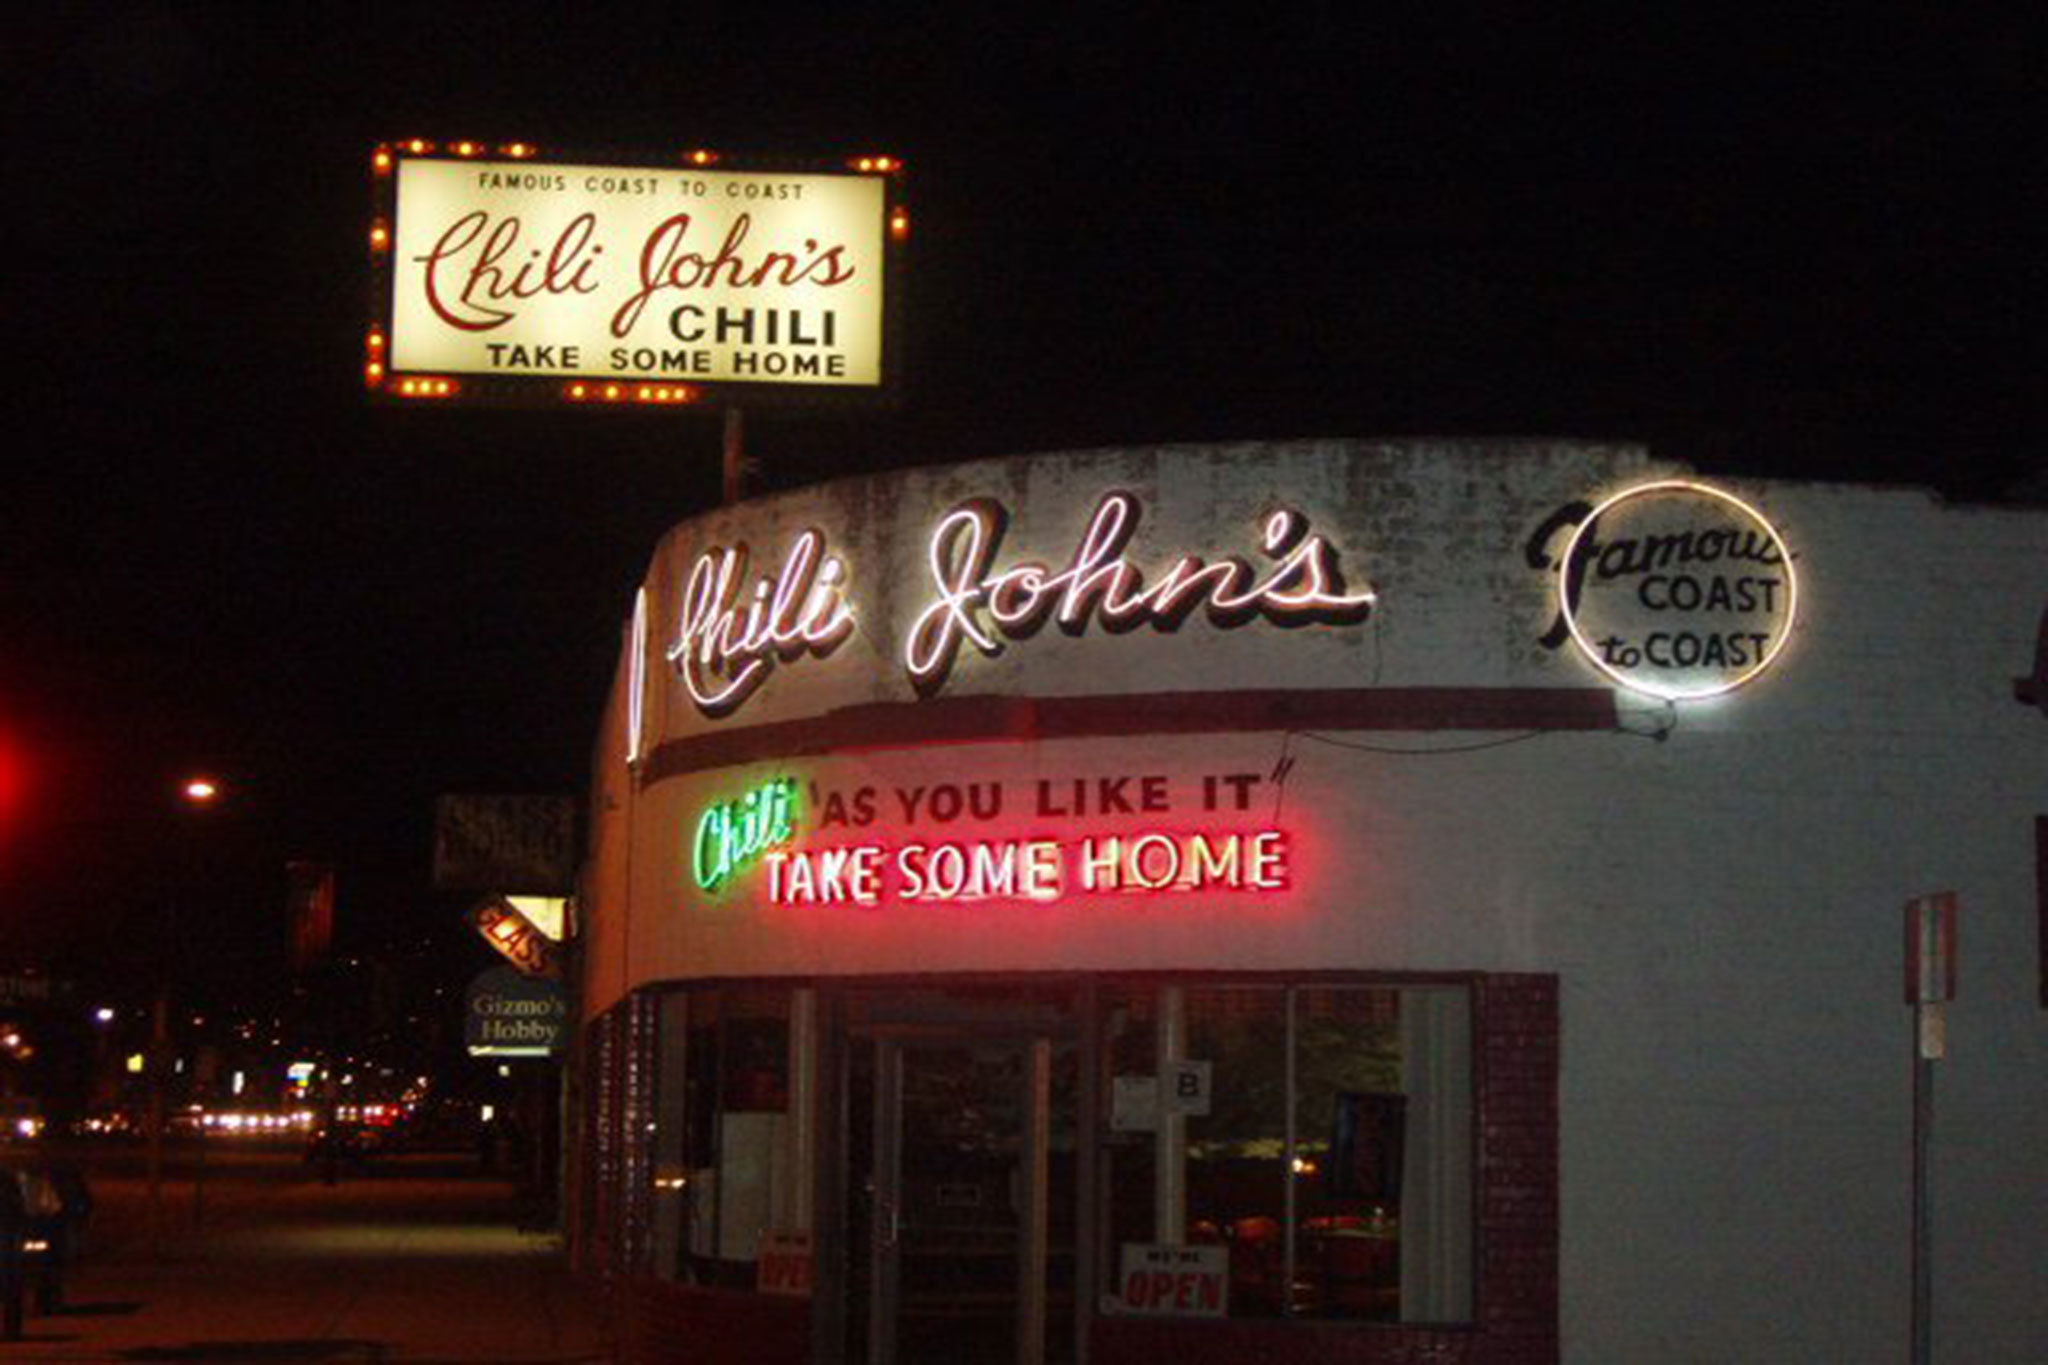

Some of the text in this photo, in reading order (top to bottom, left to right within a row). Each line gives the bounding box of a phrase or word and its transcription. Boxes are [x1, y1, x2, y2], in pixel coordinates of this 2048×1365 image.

[479, 172, 803, 199] FAMOUS COAST TO COAST
[413, 210, 856, 339] Chili John's
[668, 305, 836, 347] CHILI
[486, 344, 846, 377] TAKE SOME HOME
[666, 490, 1377, 716] Chili John's
[1638, 575, 1781, 612] COAST
[1597, 632, 1770, 668] to COAST
[894, 783, 1001, 825] YOU
[1036, 776, 1170, 817] LIKE
[693, 777, 796, 893] Chili
[765, 830, 1286, 904] TAKE SOME HOME
[481, 1019, 560, 1046] Hobby
[1177, 1072, 1199, 1098] B
[1125, 1271, 1224, 1309] OPEN
